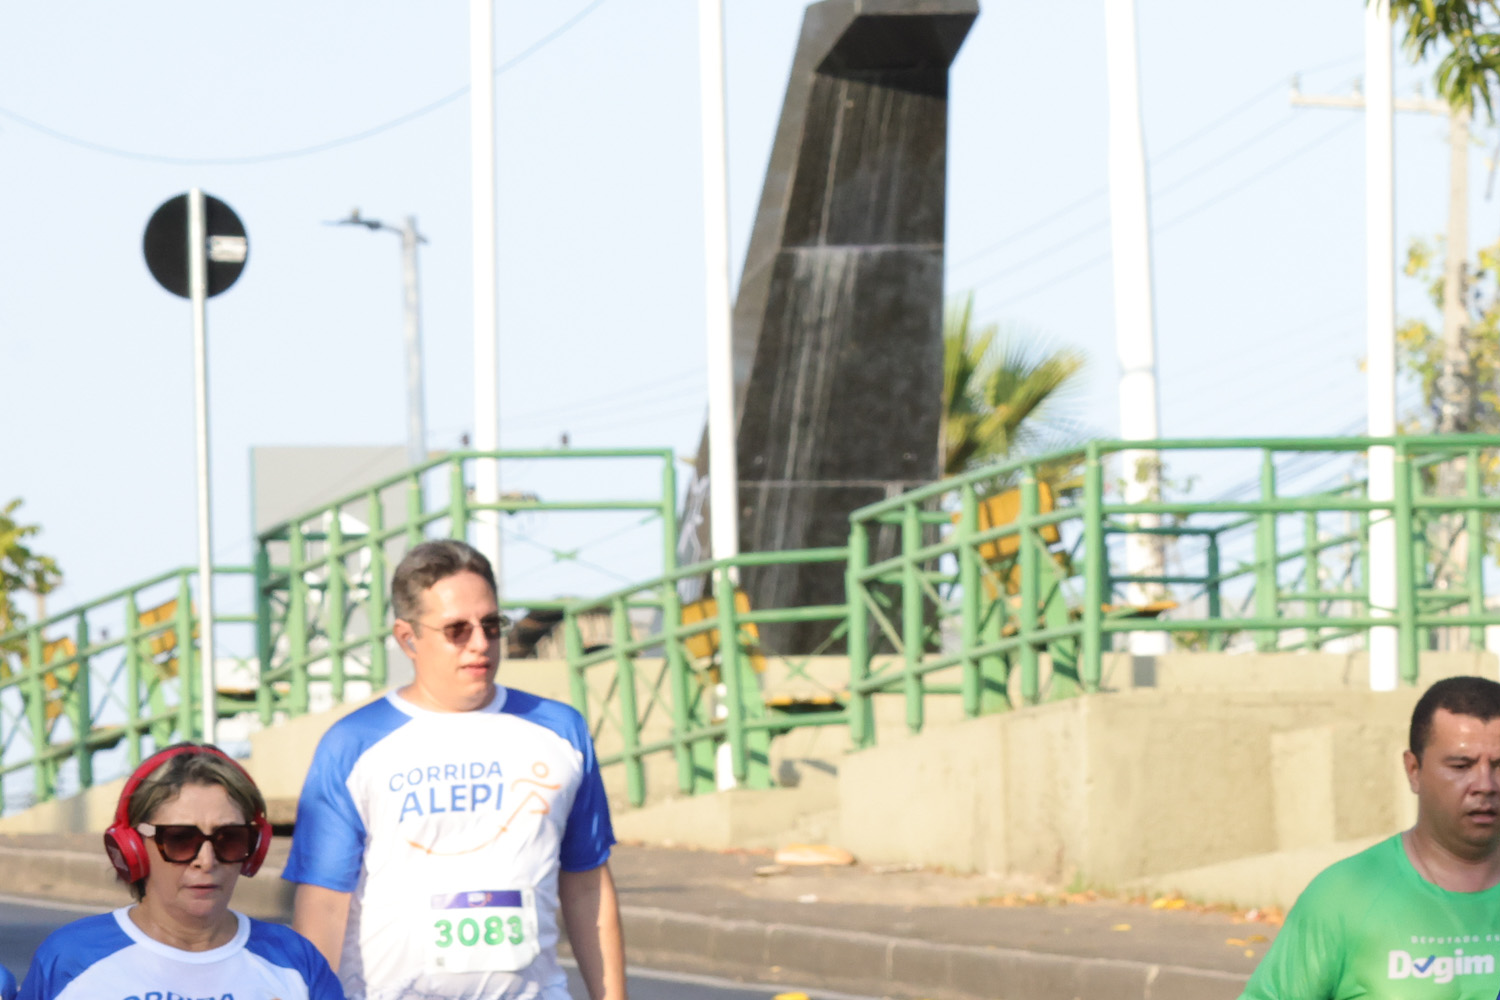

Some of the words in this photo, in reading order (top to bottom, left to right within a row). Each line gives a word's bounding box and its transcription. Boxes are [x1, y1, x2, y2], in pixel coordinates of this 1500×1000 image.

[389, 761, 503, 792] CORRIDA
[399, 783, 504, 824] ALEPI
[433, 915, 524, 948] 3083
